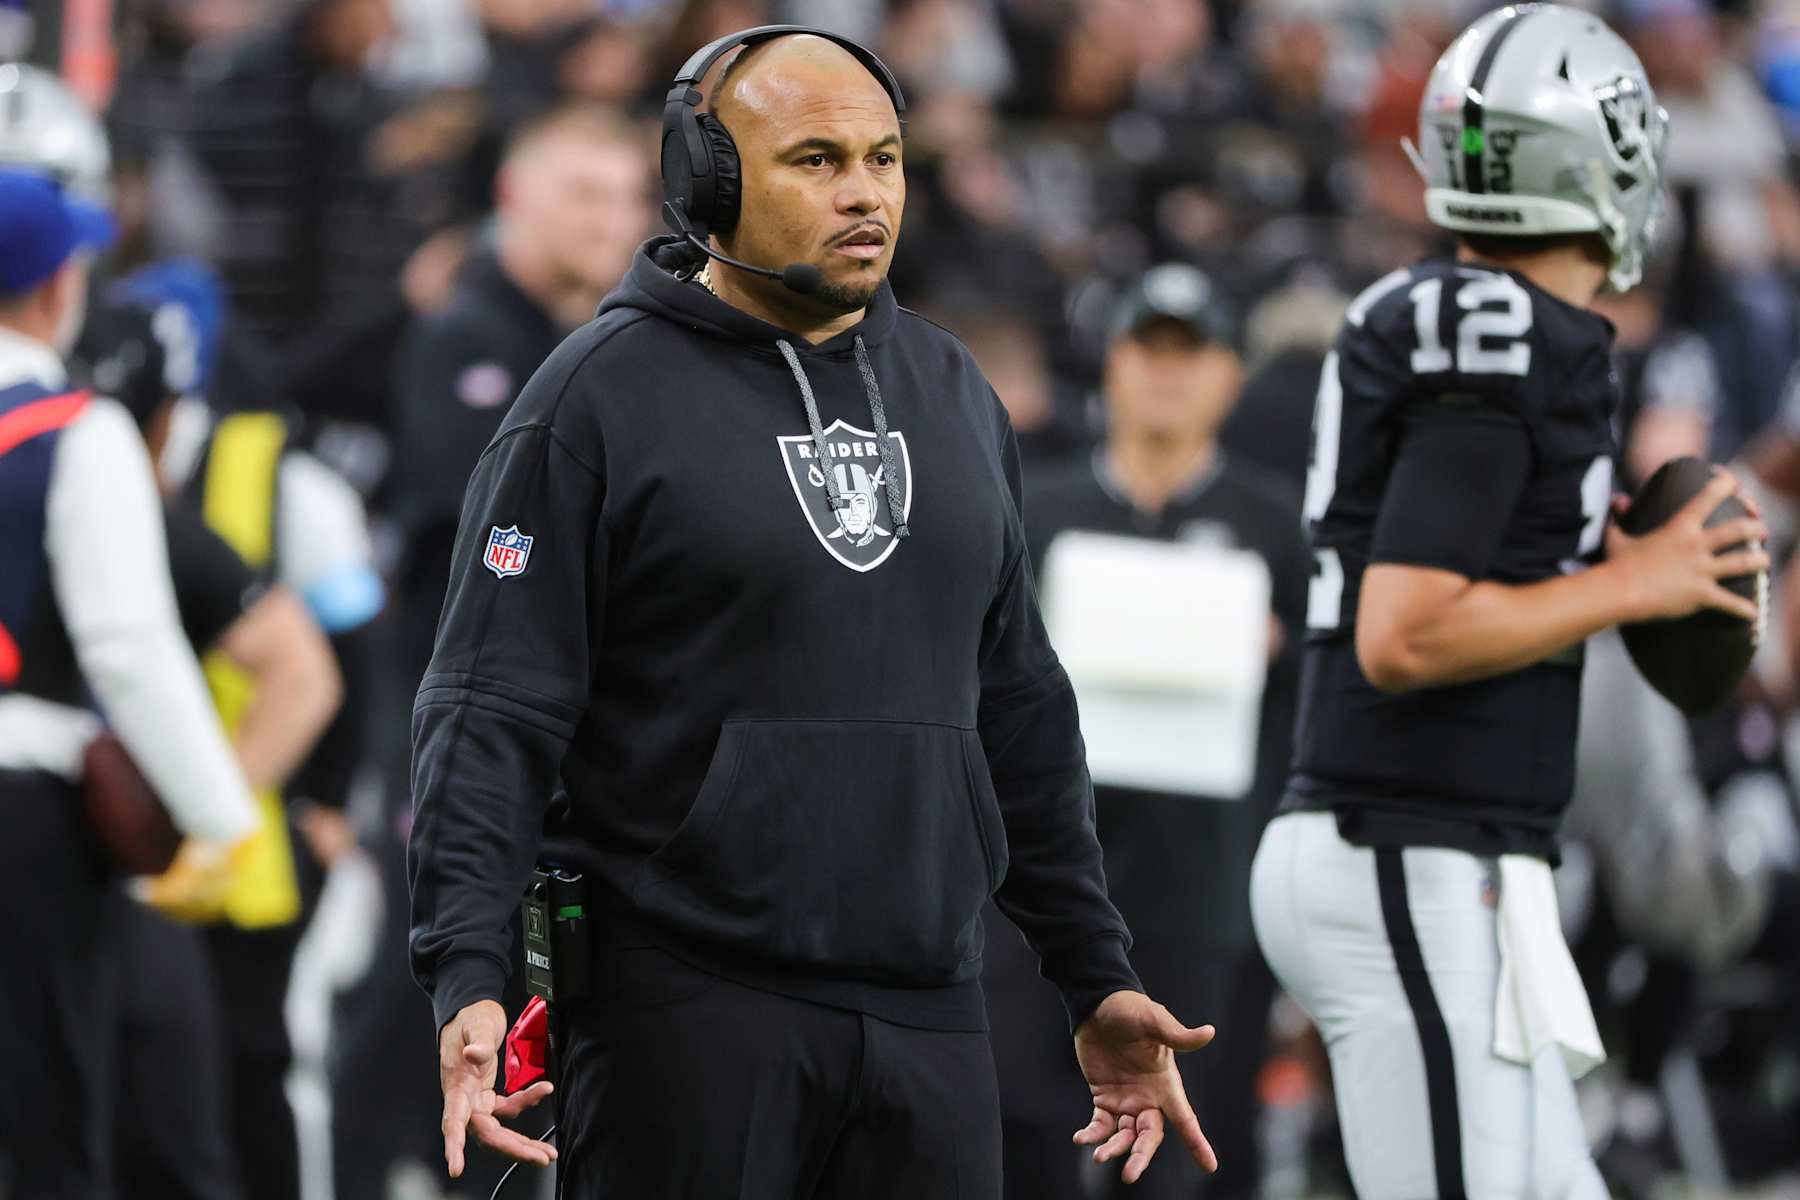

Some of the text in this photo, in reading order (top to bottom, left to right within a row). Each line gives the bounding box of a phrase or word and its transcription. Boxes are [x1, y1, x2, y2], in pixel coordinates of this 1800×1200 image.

[1409, 273, 1532, 376] 12
[797, 441, 882, 459] RIDER
[489, 545, 521, 569] NFL
